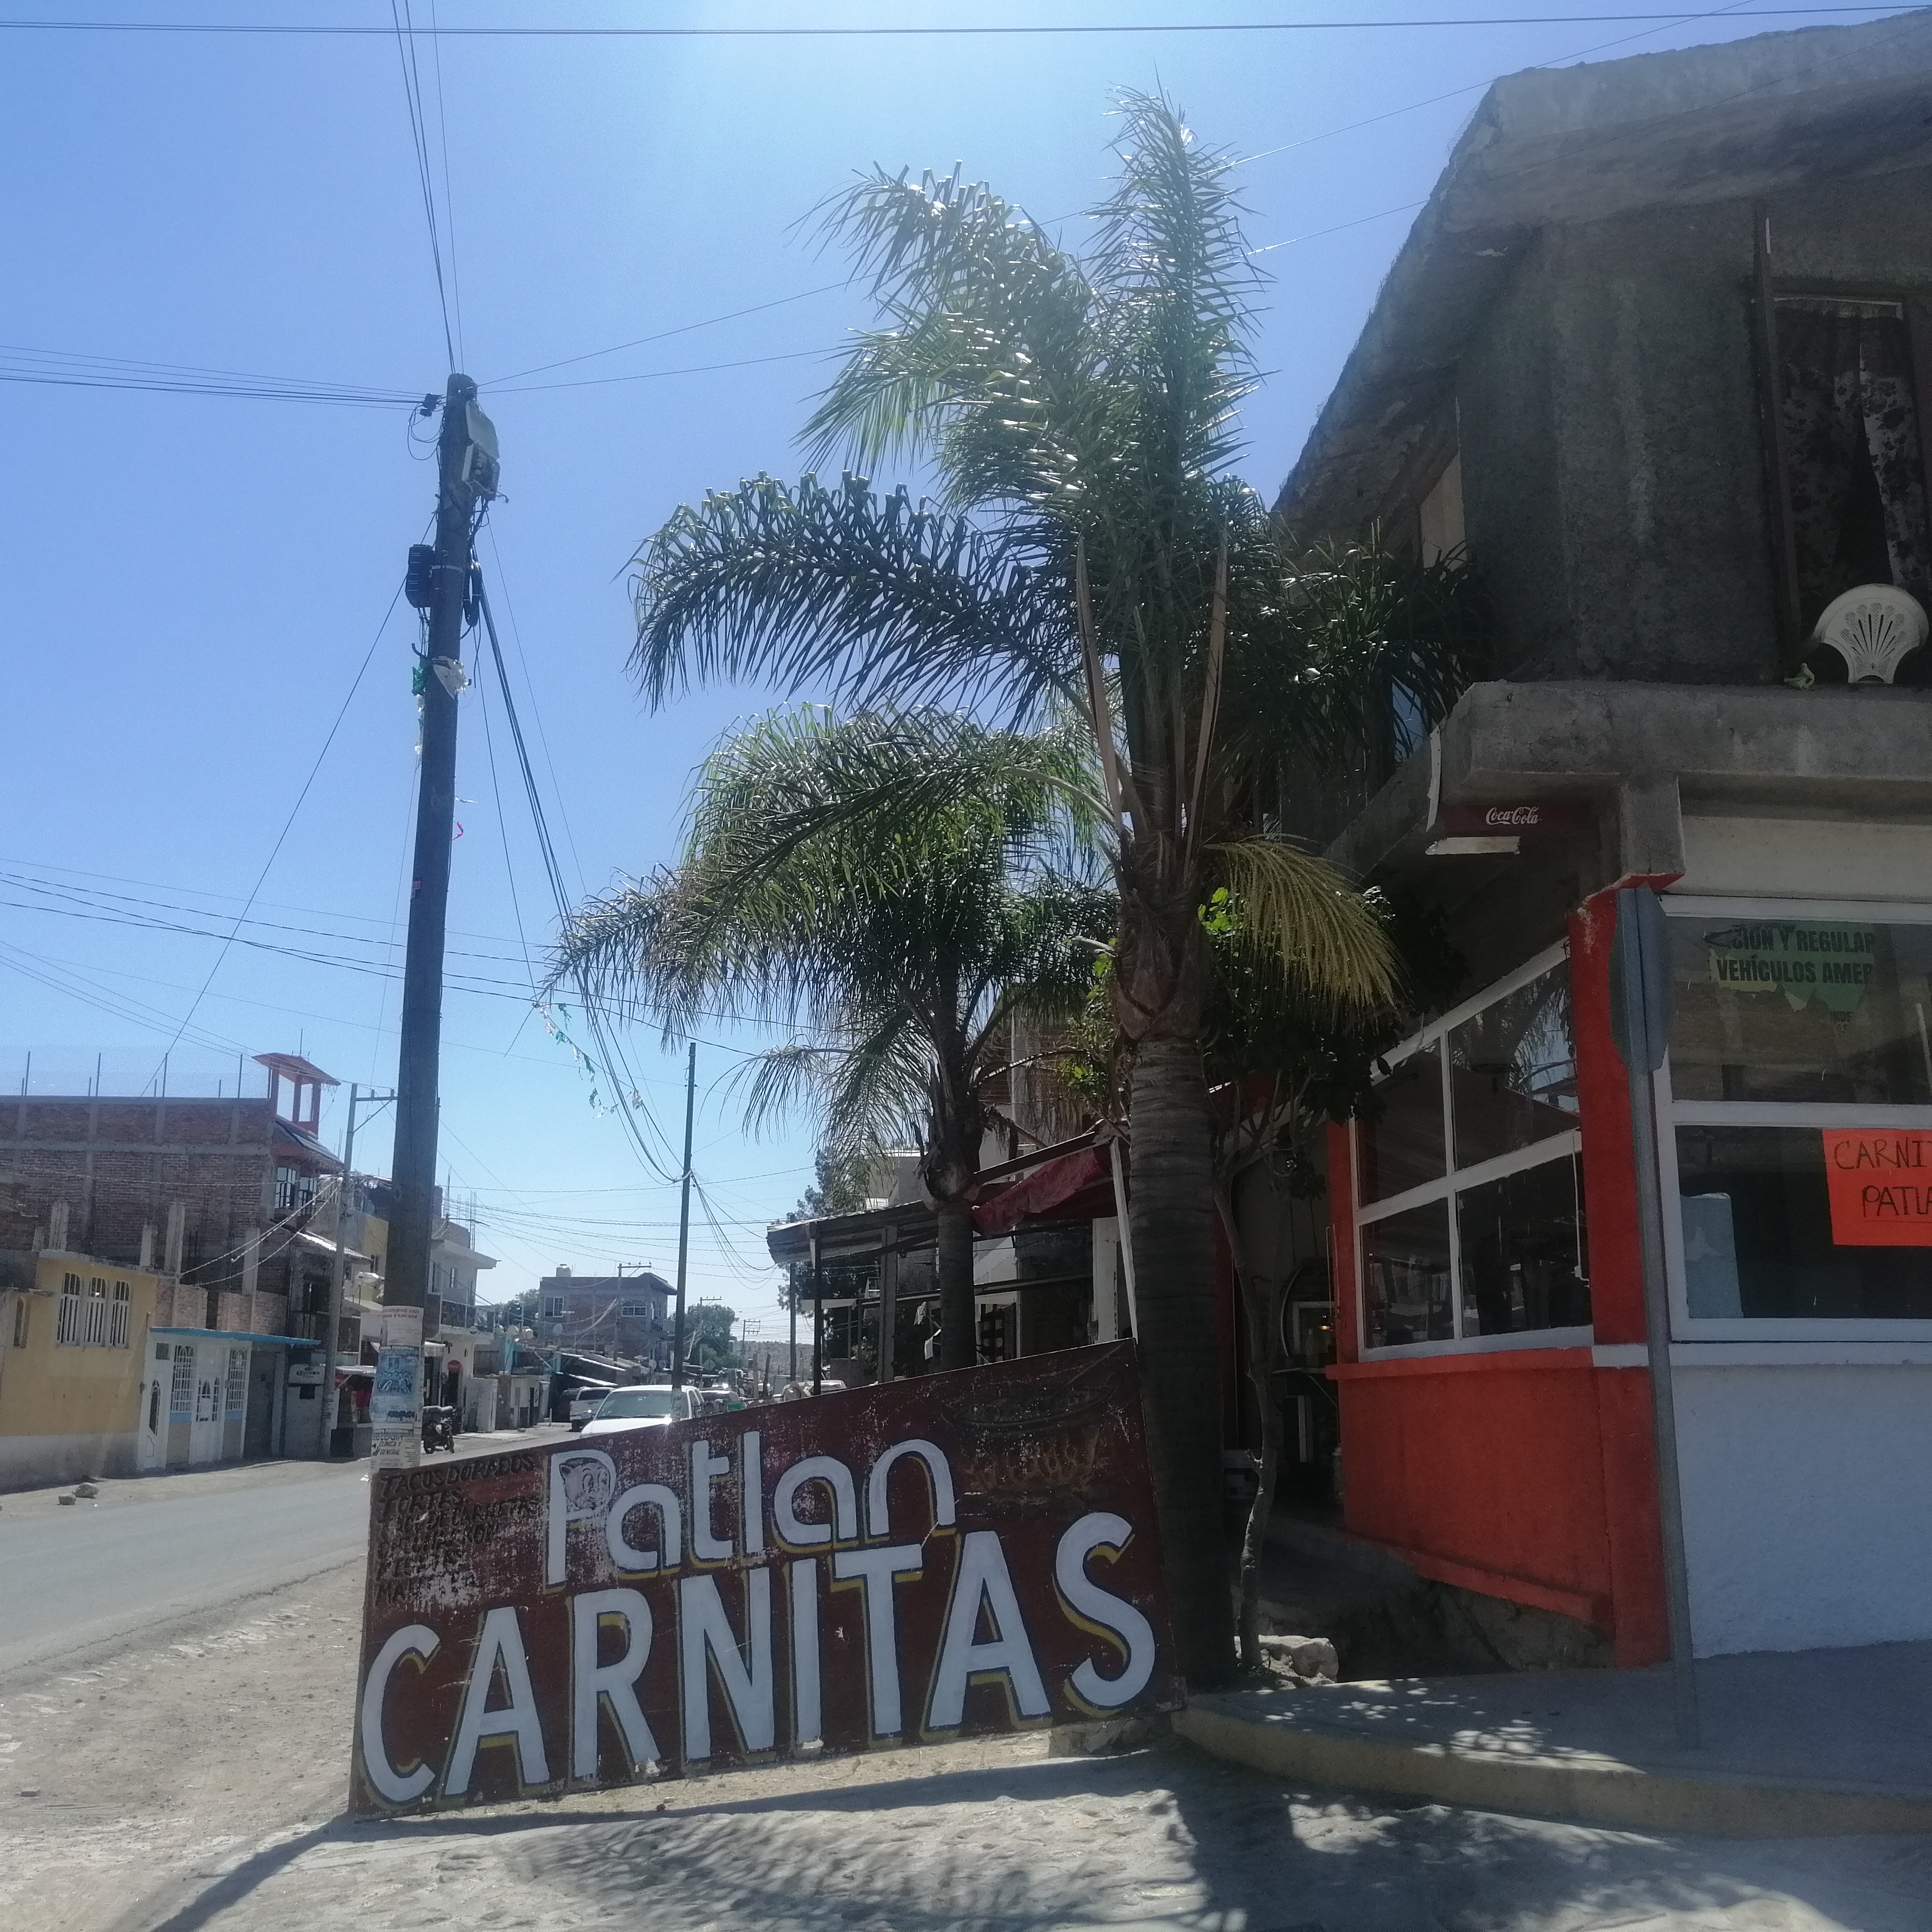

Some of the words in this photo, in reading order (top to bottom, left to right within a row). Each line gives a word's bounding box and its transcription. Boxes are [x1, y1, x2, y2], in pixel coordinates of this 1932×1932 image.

[1486, 806, 1540, 825] Coca-Cola
[1779, 927, 1795, 951] Y
[1716, 954, 1816, 983] VEHÍCULOS
[378, 1469, 445, 1497] TACOS
[546, 1430, 957, 1589] Patlan
[359, 1511, 1157, 1805] CARNITAS
